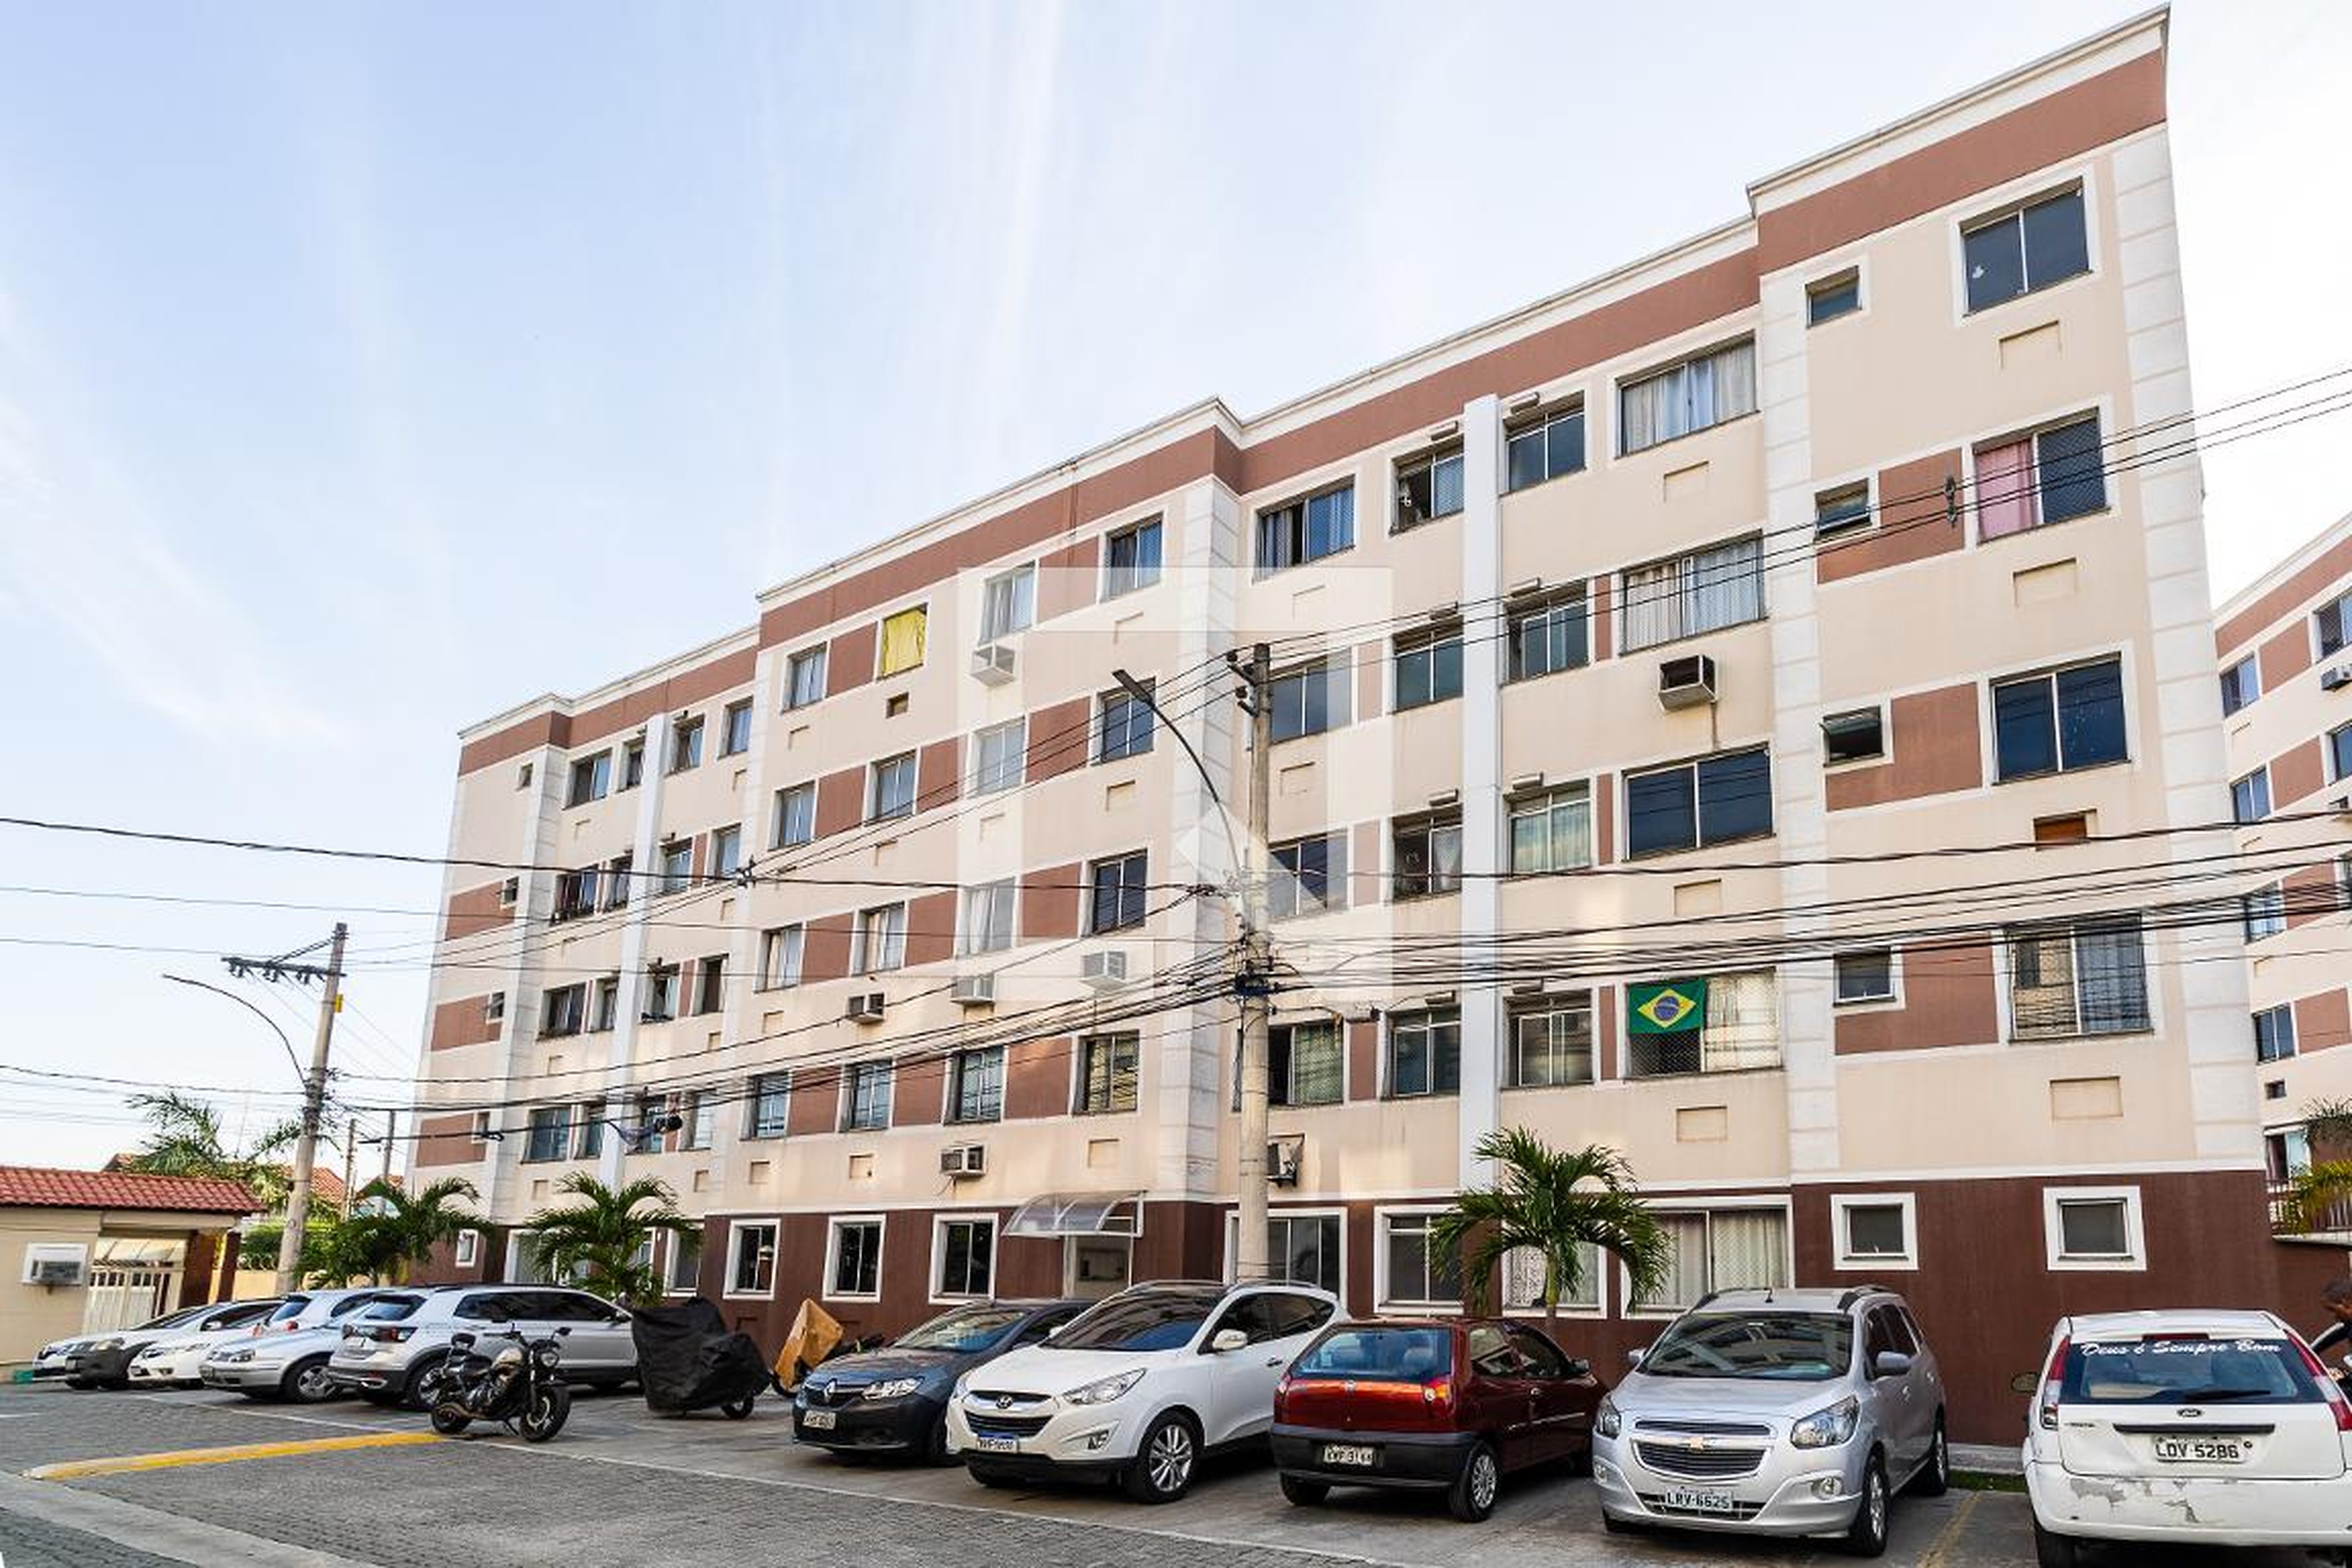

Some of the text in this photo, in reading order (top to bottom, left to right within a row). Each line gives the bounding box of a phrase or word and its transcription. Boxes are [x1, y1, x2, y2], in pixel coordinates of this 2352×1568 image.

[2081, 1343, 2128, 1355] Deus
[2152, 1341, 2228, 1355] Sempre
[2235, 1339, 2282, 1352] Bom
